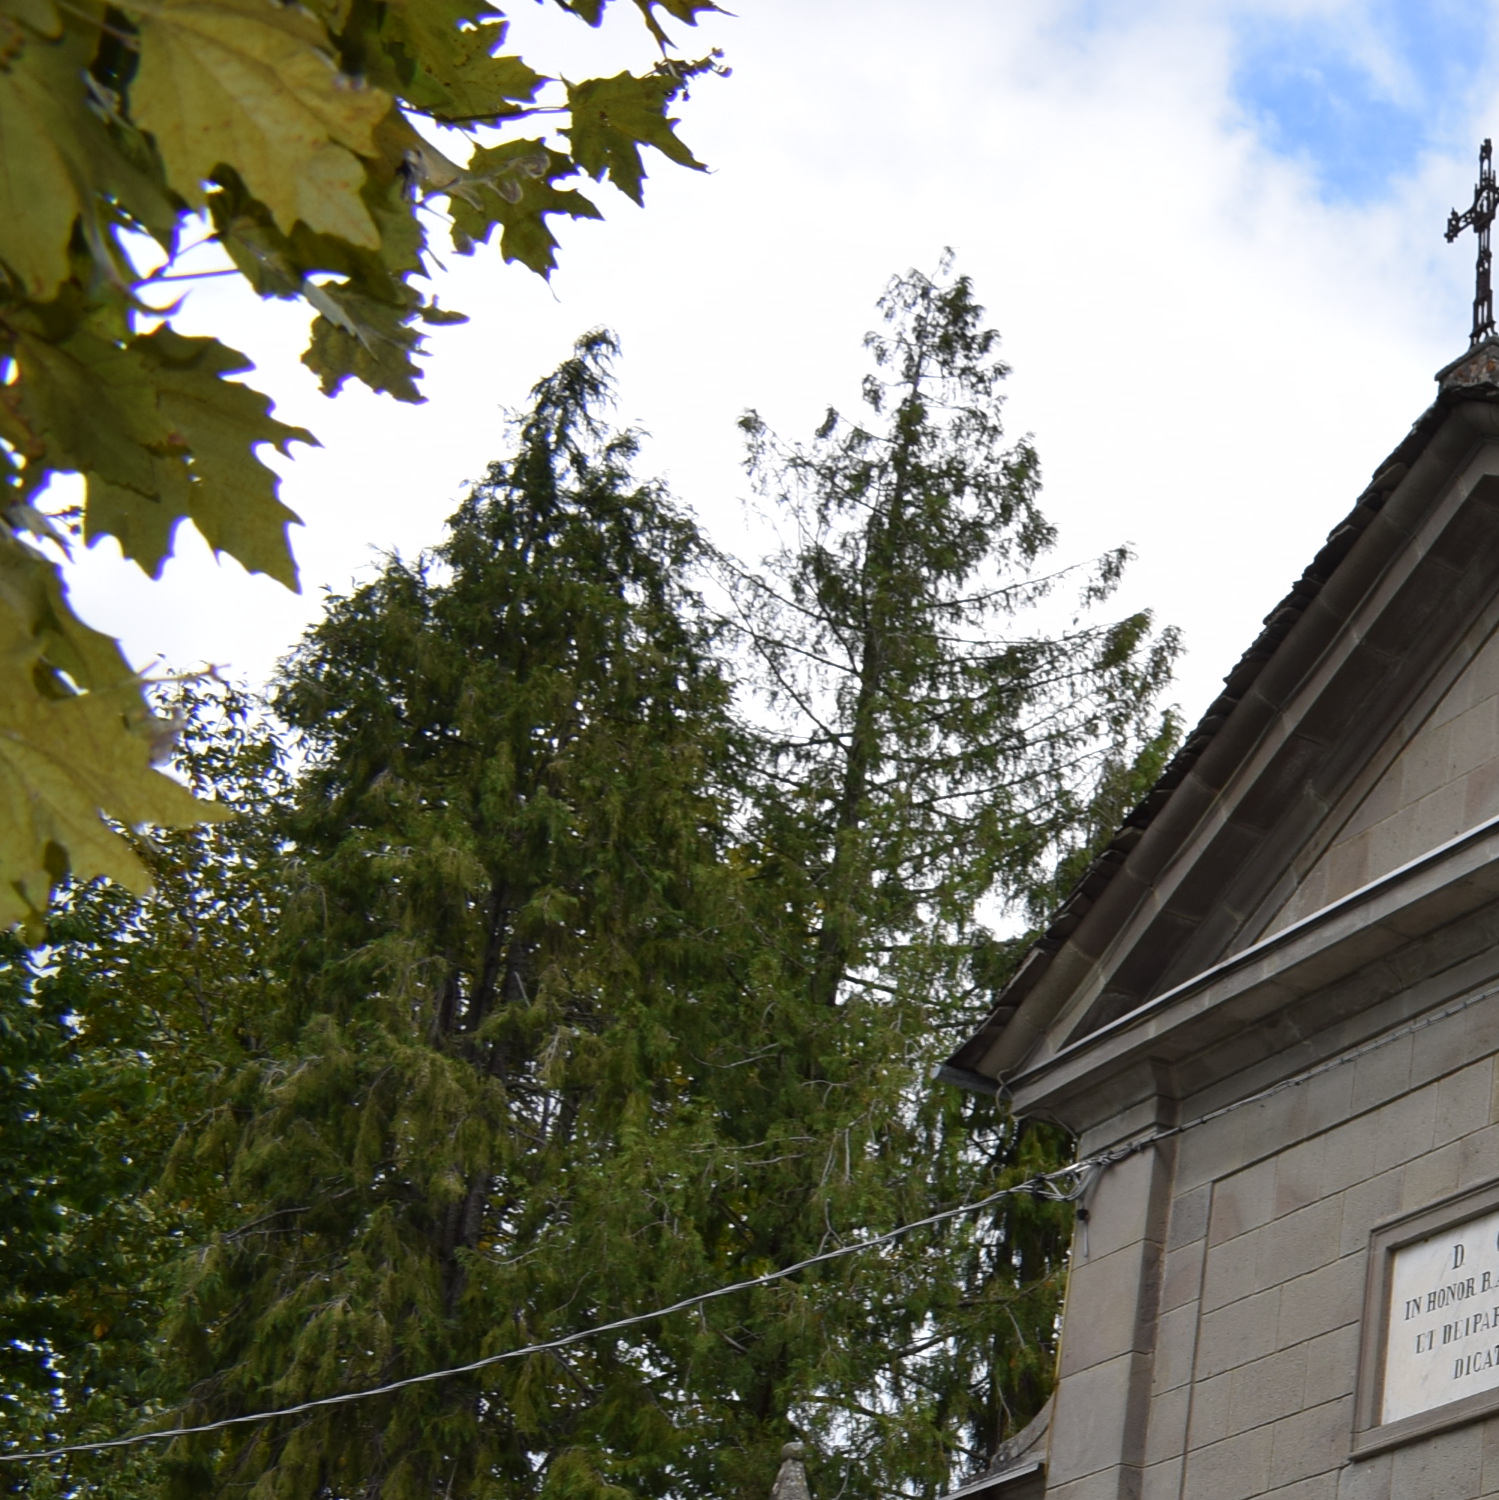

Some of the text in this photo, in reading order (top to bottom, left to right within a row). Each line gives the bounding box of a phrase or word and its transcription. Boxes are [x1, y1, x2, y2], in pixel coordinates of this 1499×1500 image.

[1404, 1296, 1422, 1321] IN
[1426, 1277, 1477, 1313] HONOR
[1415, 1328, 1436, 1354] ET
